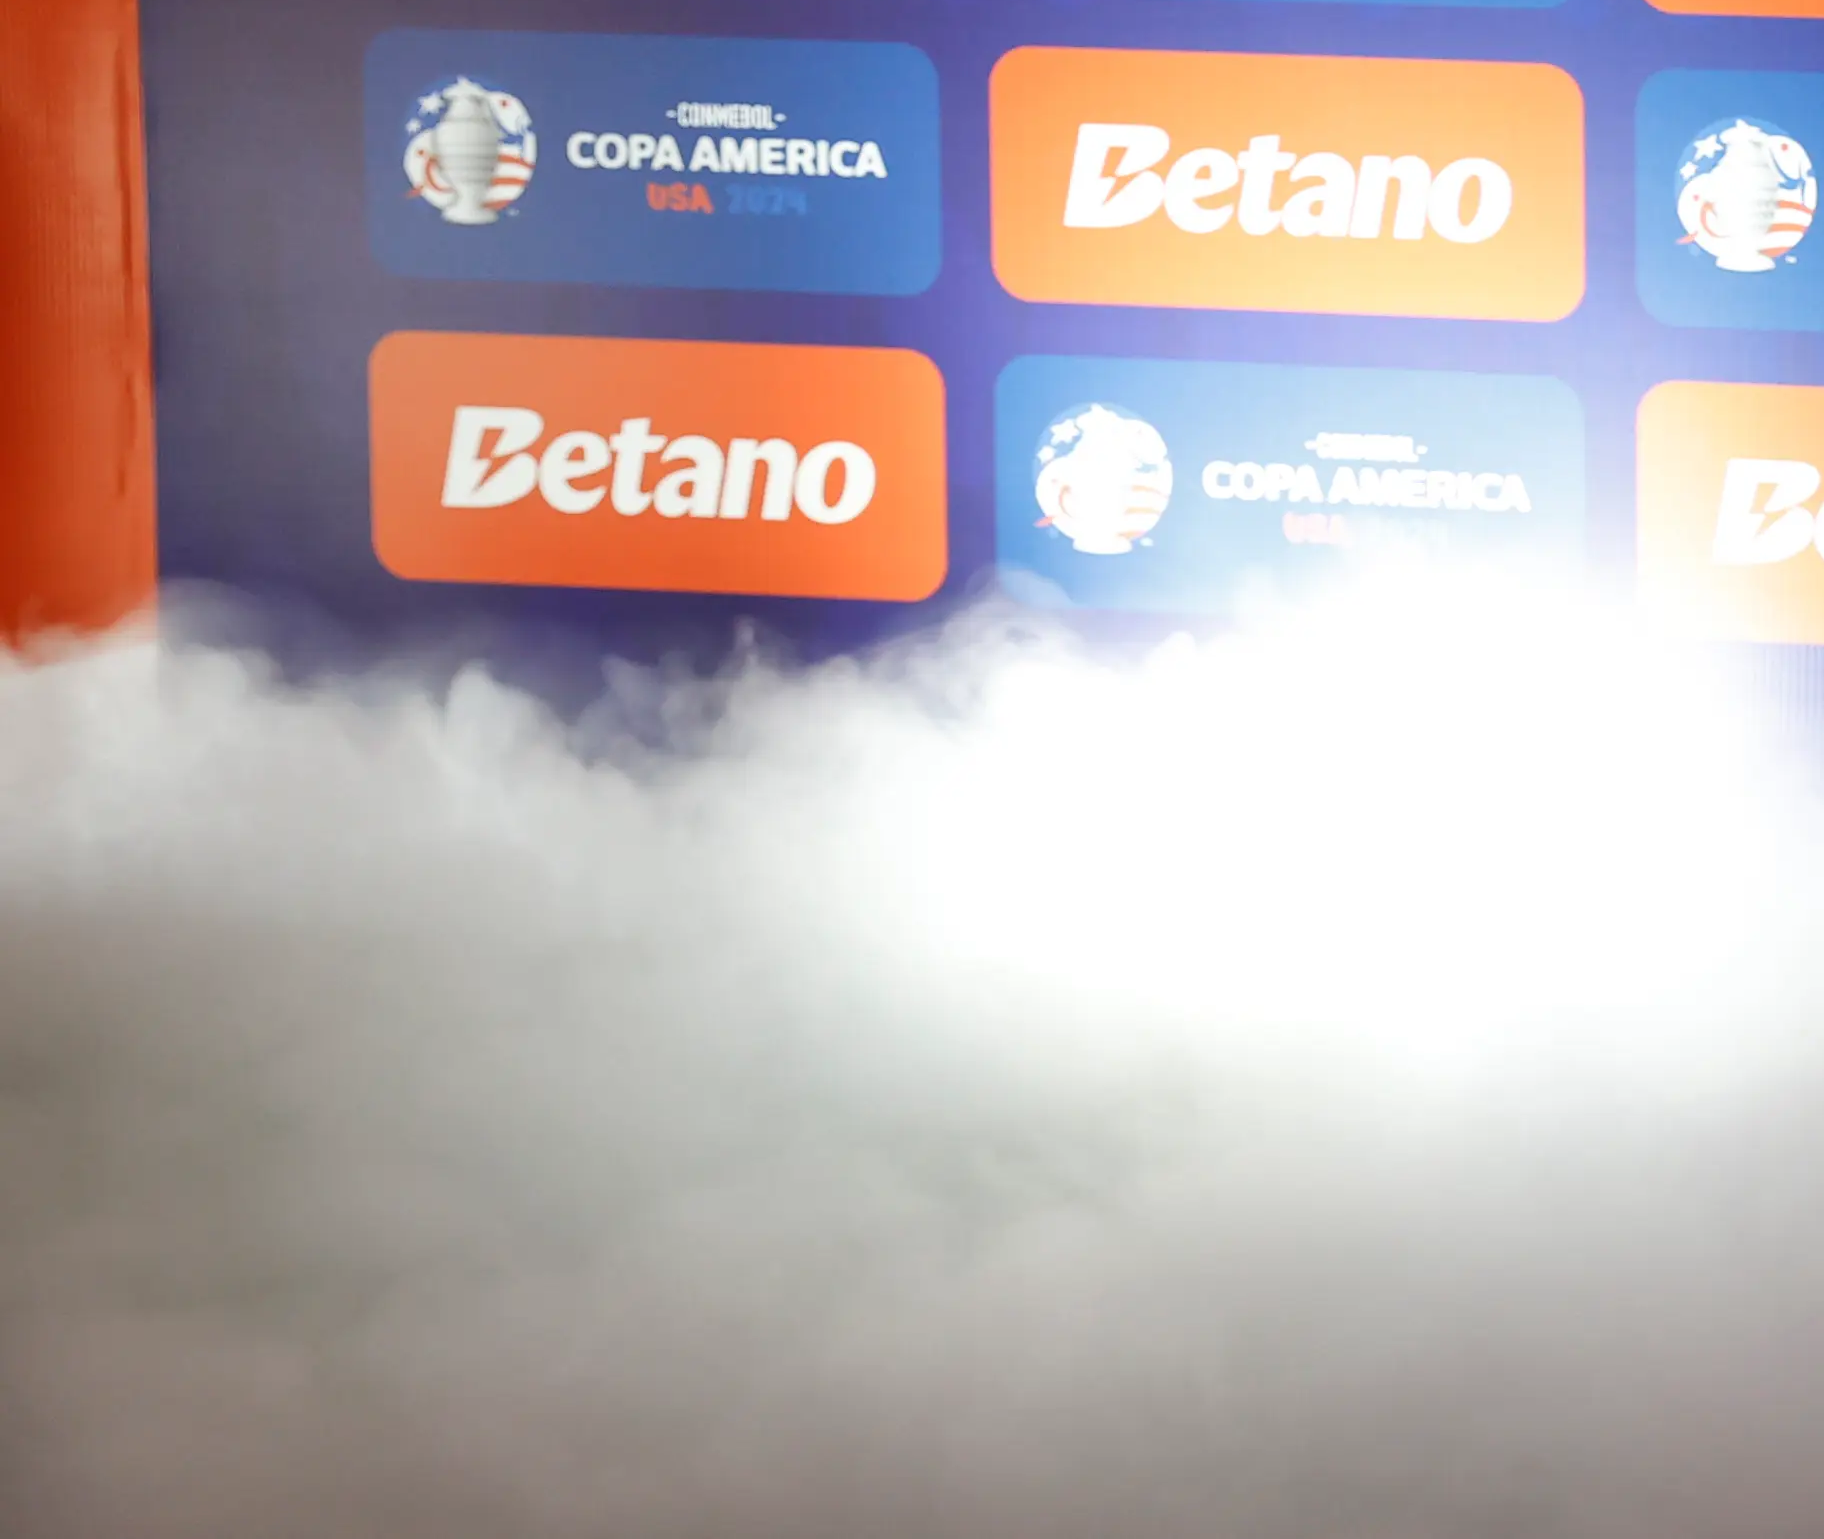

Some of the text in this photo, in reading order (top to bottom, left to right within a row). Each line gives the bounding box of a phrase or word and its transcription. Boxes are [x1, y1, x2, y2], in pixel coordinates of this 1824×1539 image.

[567, 133, 887, 178] COPA AMERICA
[649, 184, 712, 212] USA
[1064, 124, 1513, 244] Betano
[442, 407, 876, 523] Betano
[1202, 460, 1532, 513] COPA AMERICA
